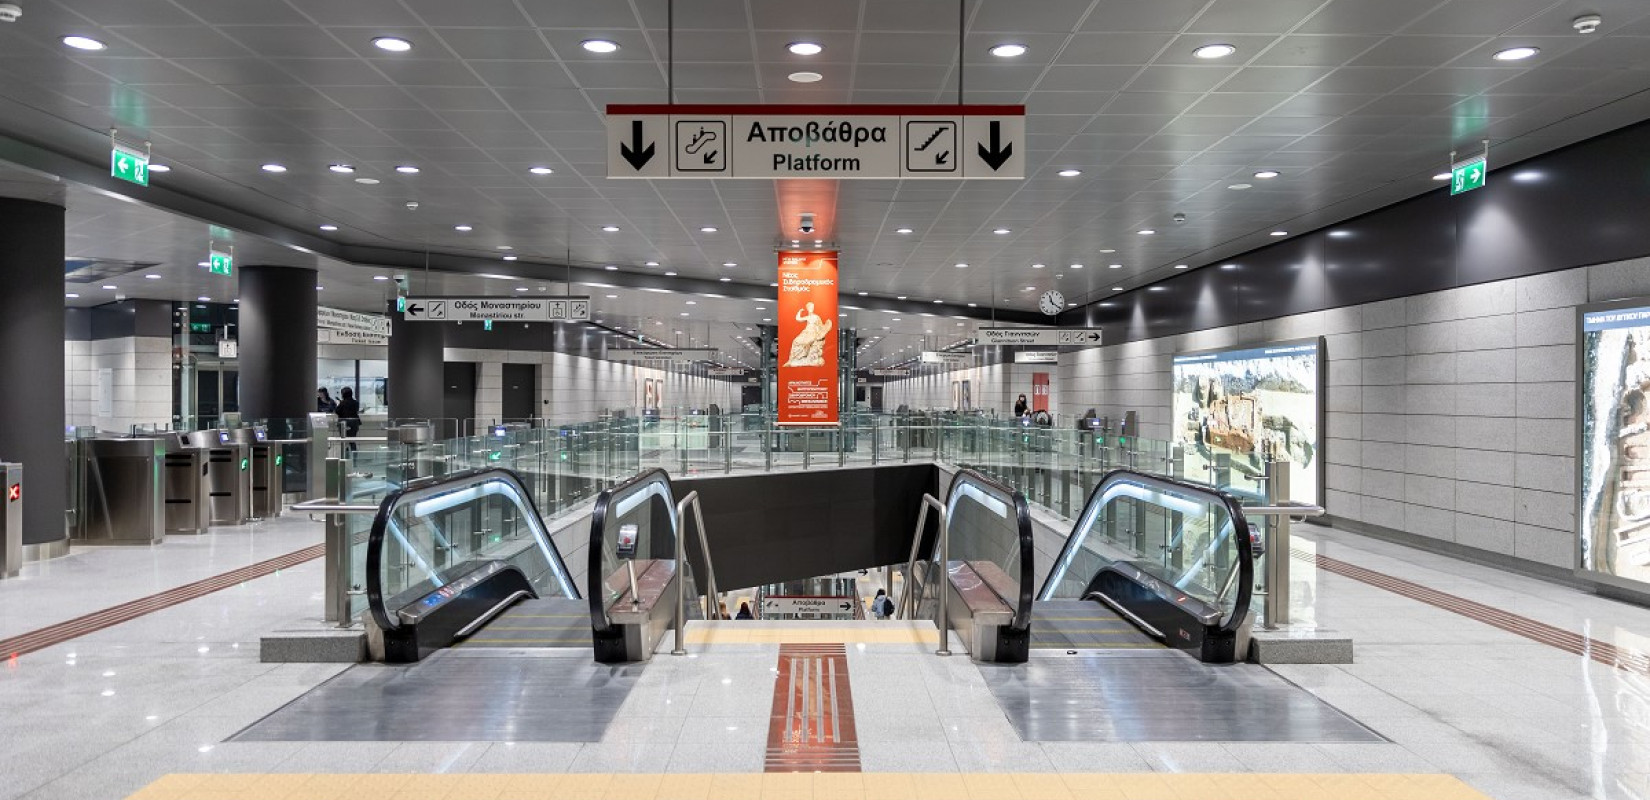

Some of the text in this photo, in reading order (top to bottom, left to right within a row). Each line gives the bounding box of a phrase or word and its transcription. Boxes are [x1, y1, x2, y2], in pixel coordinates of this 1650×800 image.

[747, 120, 887, 147] Αποβάθρα
[773, 153, 861, 171] Platform
[454, 301, 541, 311] Οδός Μοναστηρίου
